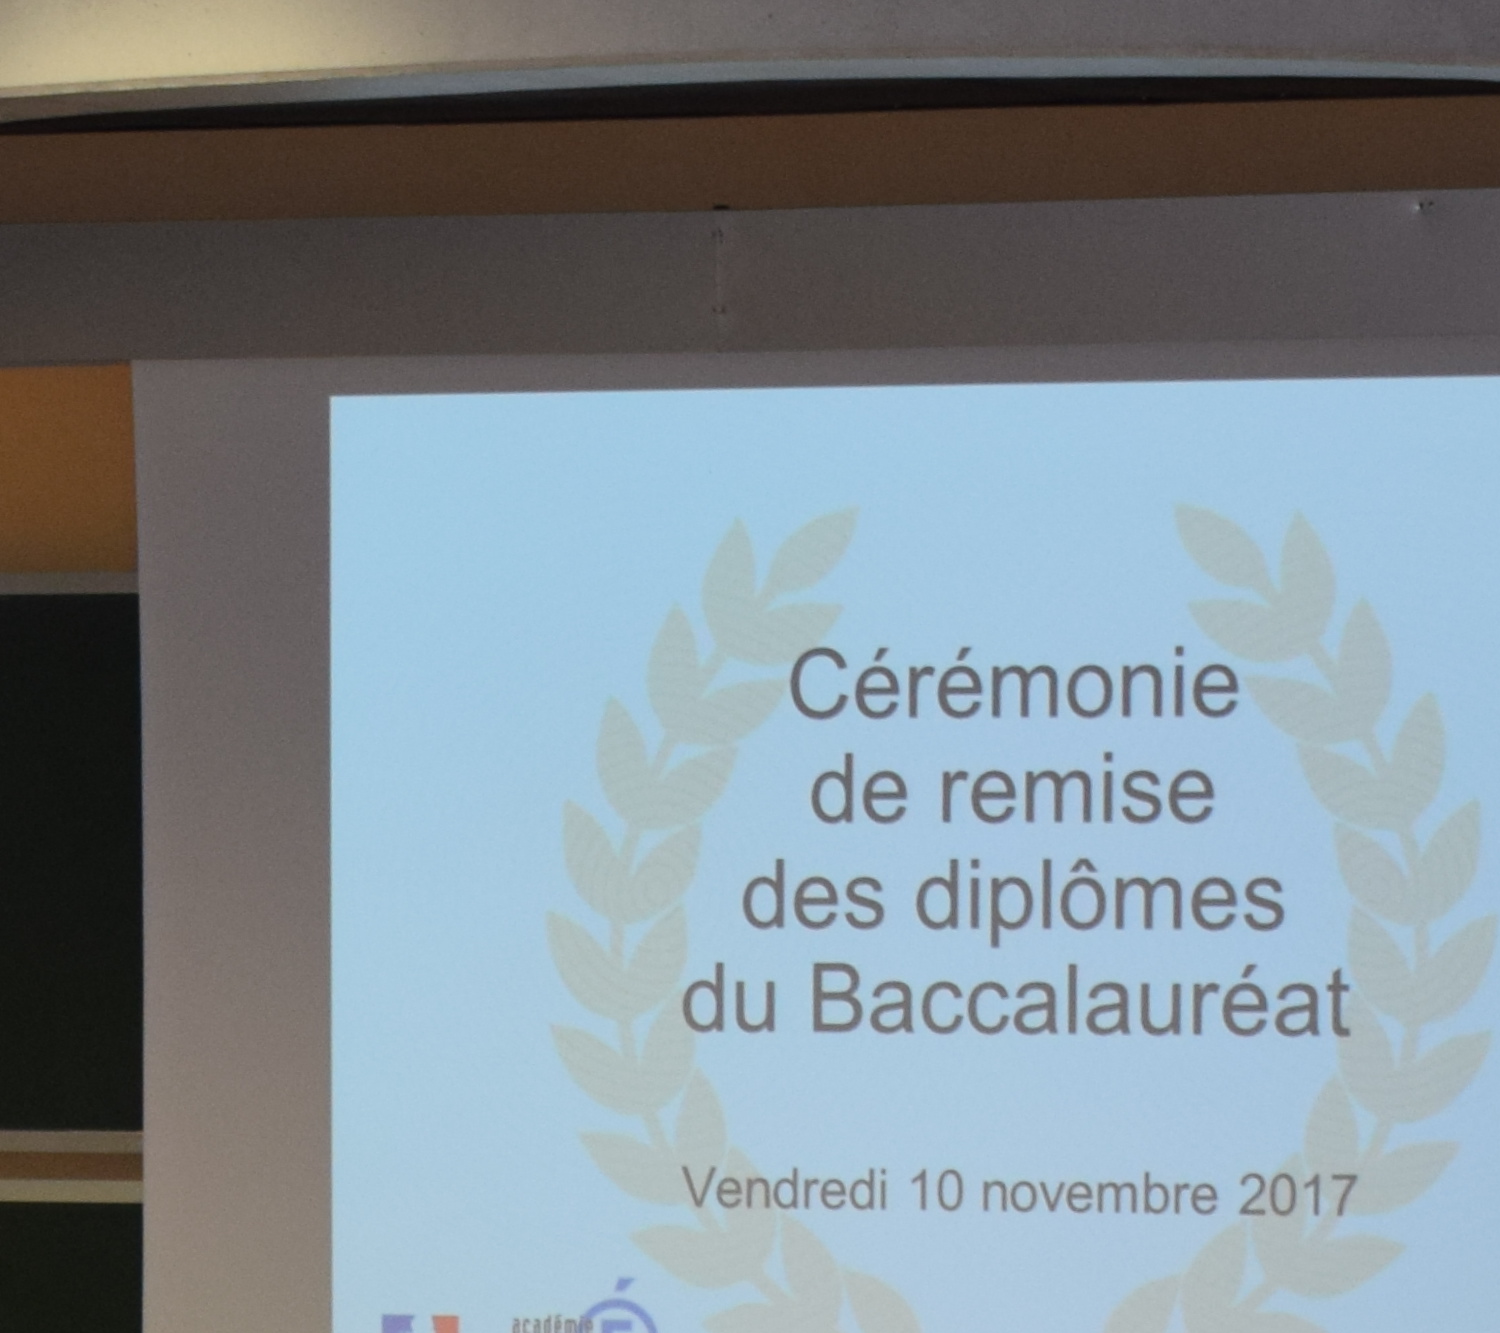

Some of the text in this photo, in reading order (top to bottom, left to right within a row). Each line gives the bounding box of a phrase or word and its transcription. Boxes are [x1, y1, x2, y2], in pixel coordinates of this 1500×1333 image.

[789, 645, 1239, 720] Cérémonie
[811, 751, 1215, 824] de remise
[742, 858, 1285, 948] des diplômes
[682, 961, 1351, 1038] du Baccalauréat
[681, 1165, 1359, 1217] Vendredi 10 novembre 2017
